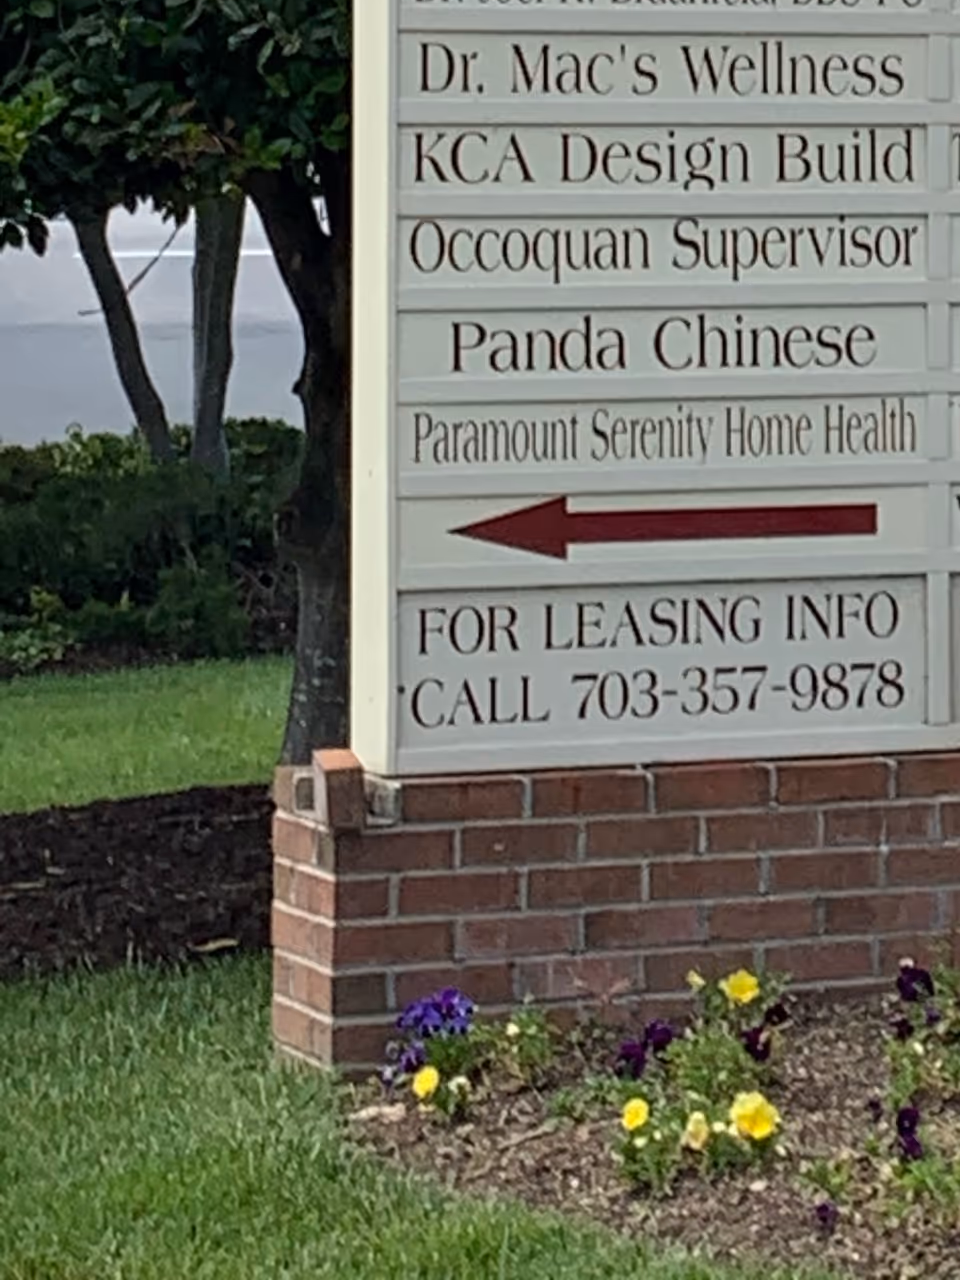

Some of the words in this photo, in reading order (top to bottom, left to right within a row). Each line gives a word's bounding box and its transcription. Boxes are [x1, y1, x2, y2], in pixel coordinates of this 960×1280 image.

[419, 42, 484, 94] Dr.
[510, 43, 658, 96] Mac's
[682, 41, 905, 96] Wellness
[413, 132, 535, 185] KCA
[560, 131, 750, 191] Design
[775, 129, 915, 184] Build
[409, 220, 650, 284] Occoquan
[671, 216, 919, 282] Supervisor
[450, 316, 628, 373] Panda
[653, 314, 877, 370] Chinese
[412, 411, 578, 465] Paramount
[590, 404, 714, 463] Serenity
[725, 404, 811, 458] Home
[824, 399, 917, 455] Health
[417, 605, 520, 655] FOR
[543, 595, 762, 652] LEASING
[786, 591, 899, 642] INFO
[410, 677, 550, 728] CALL
[571, 661, 905, 721] 703-357-9878
